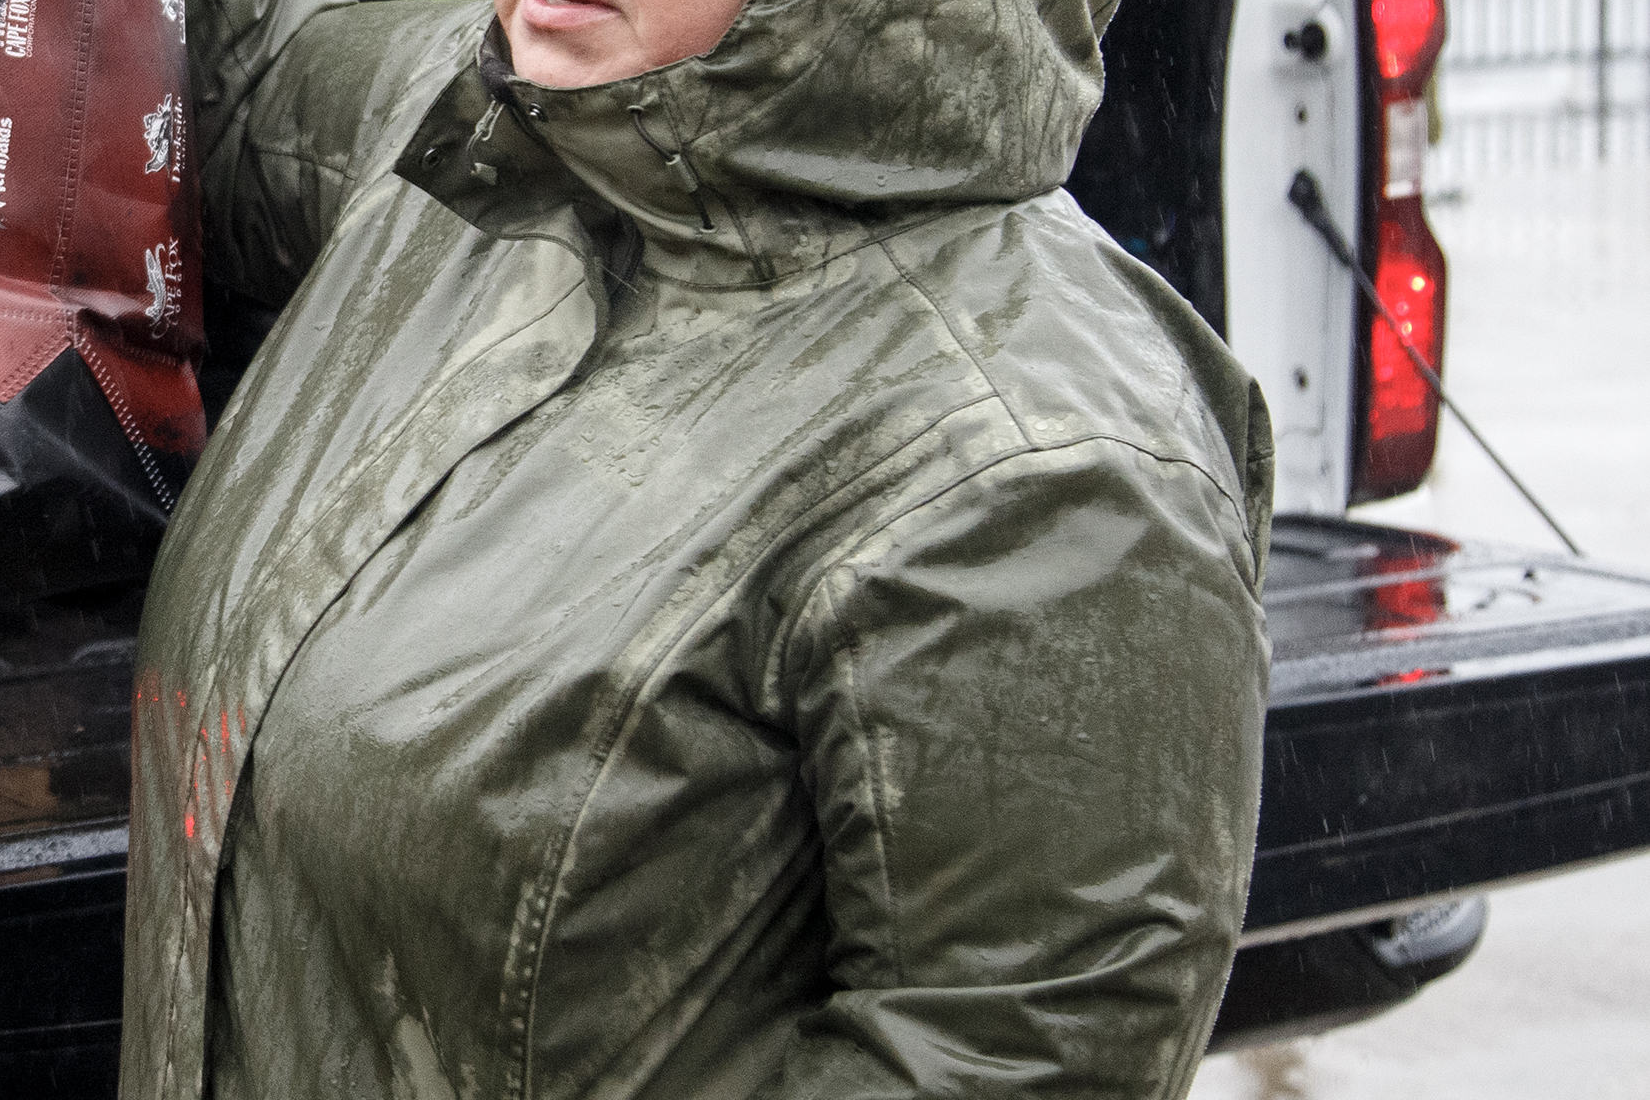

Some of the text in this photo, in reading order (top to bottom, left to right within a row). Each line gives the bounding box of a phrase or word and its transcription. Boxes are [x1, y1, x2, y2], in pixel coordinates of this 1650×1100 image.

[5, 22, 28, 57] CAPE
[152, 236, 179, 338] CAPE FOX
